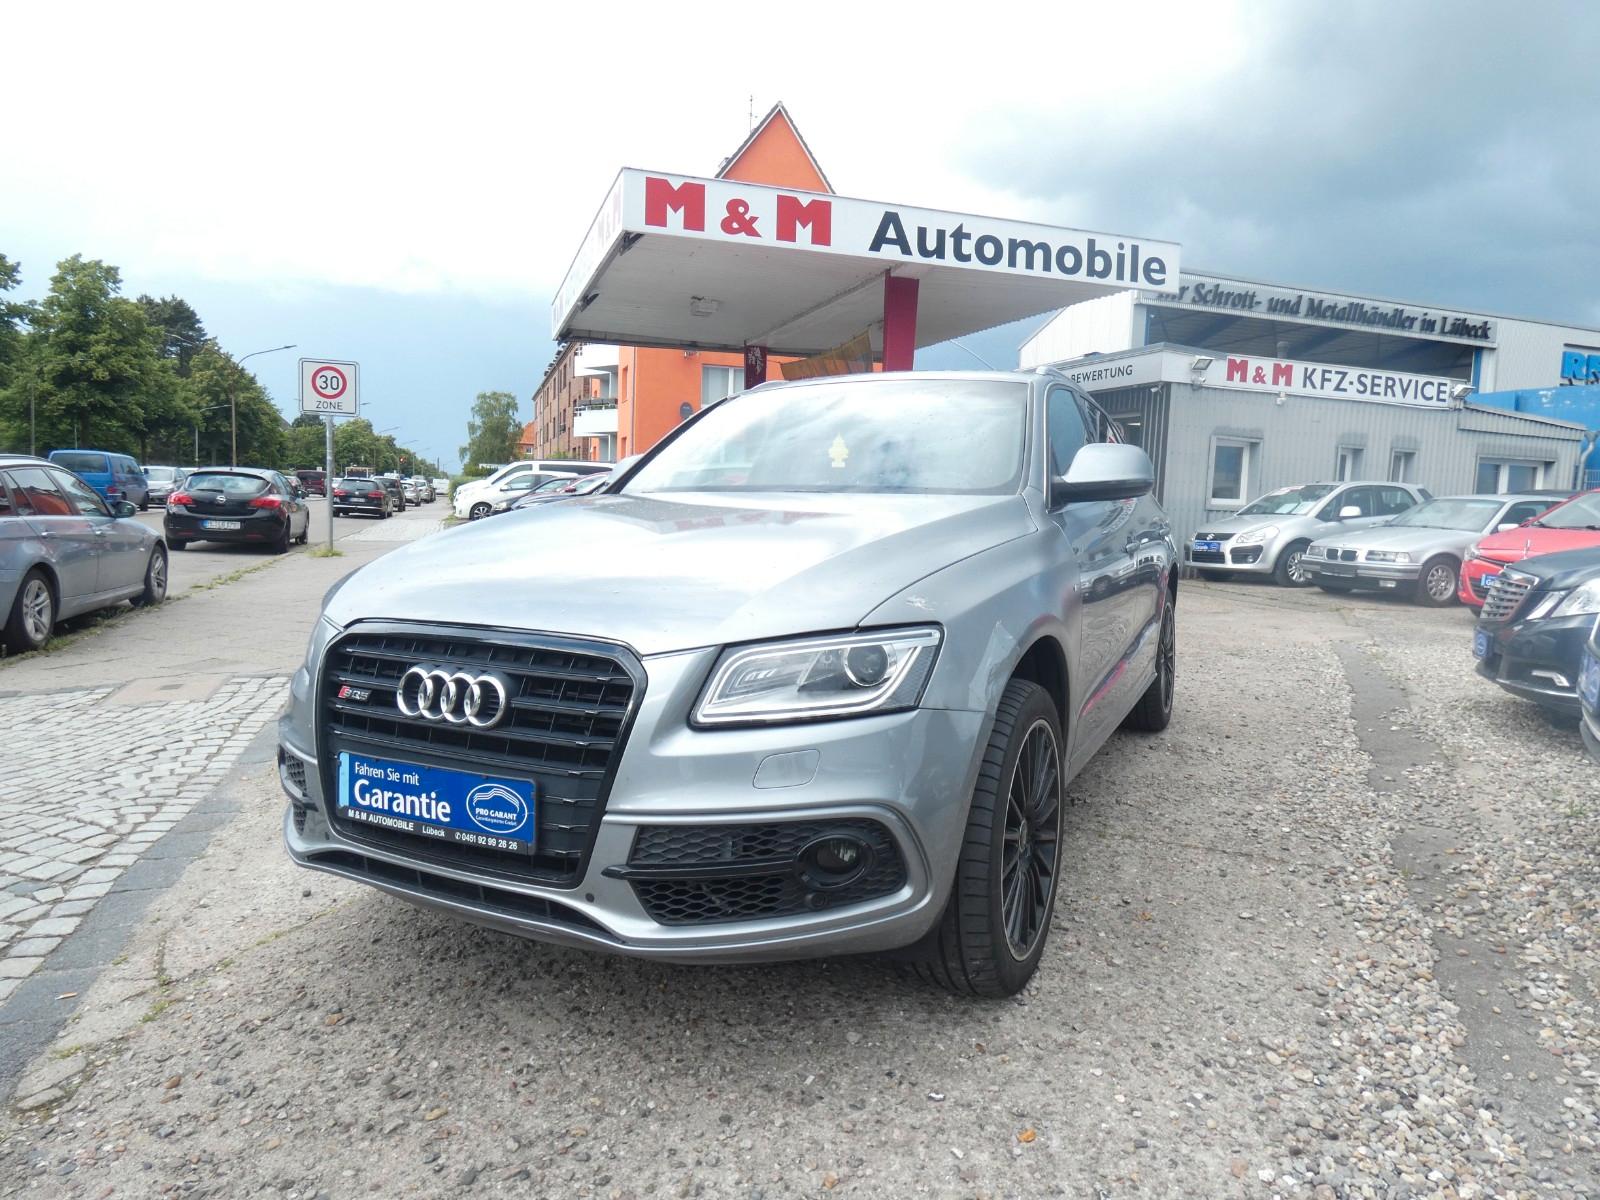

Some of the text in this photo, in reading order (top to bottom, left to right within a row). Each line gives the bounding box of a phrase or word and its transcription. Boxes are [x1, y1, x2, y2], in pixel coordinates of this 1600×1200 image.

[644, 176, 1168, 287] M & M Automobile
[1191, 282, 1262, 309] Schrott-
[1266, 294, 1303, 315] und
[1304, 297, 1418, 330] Metallhändler
[1420, 312, 1436, 333] in
[1439, 316, 1491, 340] Lübeck
[318, 374, 340, 391] 30
[1226, 357, 1249, 383] M
[1252, 365, 1266, 385] &
[1271, 362, 1294, 387] M
[315, 400, 343, 411] ZONE
[354, 761, 420, 786] Fahren Sie mit
[354, 778, 451, 822] Garantie
[475, 807, 517, 820] PRO GARANT
[348, 808, 354, 818] M
[360, 812, 367, 820] M
[368, 813, 414, 831] AUTOMOBILE
[422, 825, 445, 837] Lübeck
[461, 832, 477, 843] 0451
[477, 835, 486, 845] 92
[487, 837, 497, 847] 99
